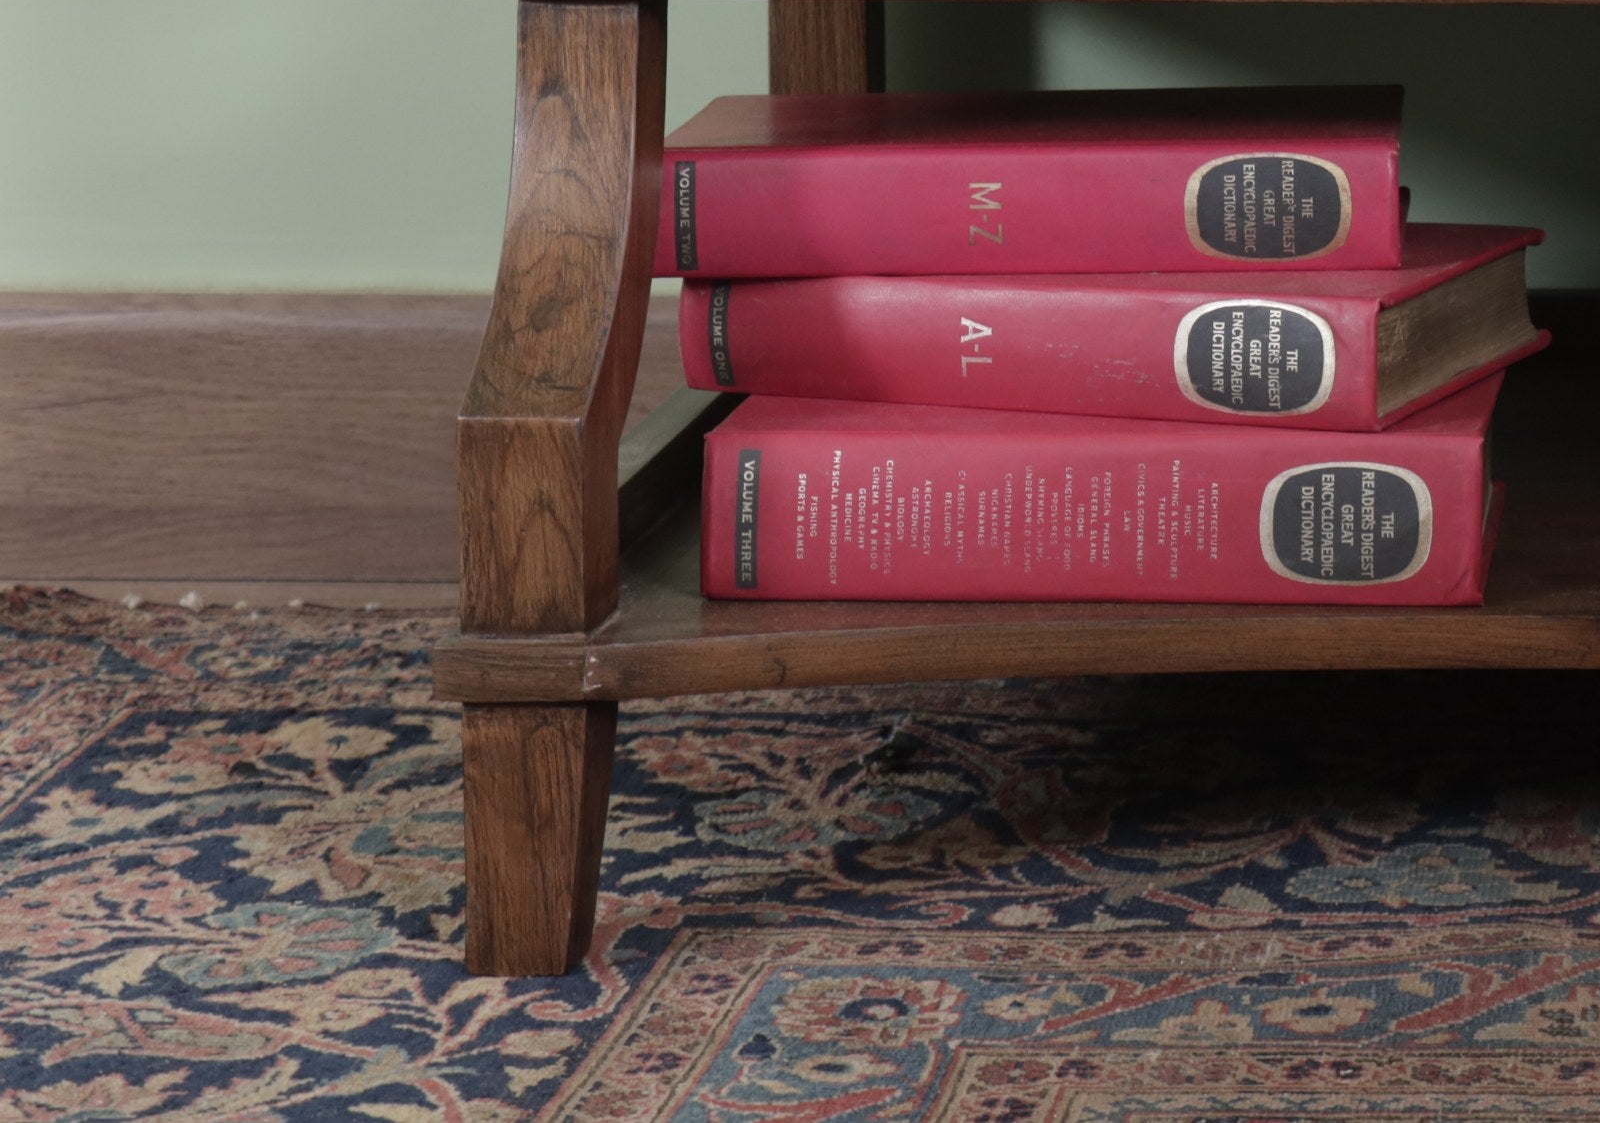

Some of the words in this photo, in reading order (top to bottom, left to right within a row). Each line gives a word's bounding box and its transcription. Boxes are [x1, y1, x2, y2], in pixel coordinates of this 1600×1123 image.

[679, 167, 690, 228] VOLUME
[968, 182, 1004, 246] M-Z
[1223, 174, 1237, 243] DICTIONARY
[1243, 164, 1257, 253] ENCYCLOPAEDIC
[1263, 190, 1276, 227] GREAT
[1301, 197, 1314, 219] THE
[681, 233, 692, 264] TWO
[1282, 215, 1296, 254] DIGEST
[712, 286, 725, 346] VOLUME
[1268, 309, 1282, 364] READER'S
[714, 351, 729, 381] ONE
[960, 316, 993, 378] A-L
[1211, 321, 1225, 393] DICTIONARY
[1230, 311, 1244, 405] ENCYCLOPAEDIC
[1249, 339, 1262, 378] GREAT
[1286, 349, 1298, 373] THE
[1268, 367, 1281, 409] DIGEST
[742, 460, 756, 524] VOLUME
[796, 473, 807, 512] SPORTS
[831, 450, 842, 500] PHYSICAL
[871, 466, 880, 505] CINEMA
[884, 459, 894, 517] CHEMISTRY
[957, 470, 966, 526] CASSICAL
[1064, 466, 1073, 522] LANGUAGE
[1103, 471, 1112, 516] FOREIGN
[1137, 463, 1146, 497] CIVICS
[1171, 459, 1180, 507] PAINTING
[809, 496, 818, 538] FISHING
[844, 493, 853, 543] MEDICINE
[858, 487, 867, 550] GEOGRAPHY
[871, 512, 879, 525] TV
[896, 496, 905, 542] BIOLOGY
[923, 479, 932, 556] ARCHAEOLOGY
[944, 491, 952, 547] RELIGIONS
[977, 490, 986, 546] SURNAMES
[1090, 476, 1099, 525] GENERAL
[1123, 510, 1131, 532] LAW
[1157, 496, 1166, 545] THEATRE
[1184, 504, 1192, 537] MUSIC
[1196, 488, 1205, 551] LITERATURE
[1209, 482, 1219, 560] ARCHITECTURE
[1301, 486, 1315, 563] DICTIONARY
[1320, 474, 1335, 576] ENCYCLOPAEDIC
[1341, 504, 1354, 546] GREAT
[1361, 471, 1376, 530] READER'S
[1381, 512, 1395, 538] THE
[741, 529, 753, 582] THREE
[796, 525, 804, 560] GAMES
[829, 504, 839, 585] ANTHROPOLOGY
[1063, 525, 1072, 539] OF
[1089, 529, 1097, 563] SLANG
[1169, 520, 1178, 580] SCULPTURE
[1361, 533, 1375, 578] DIGEST
